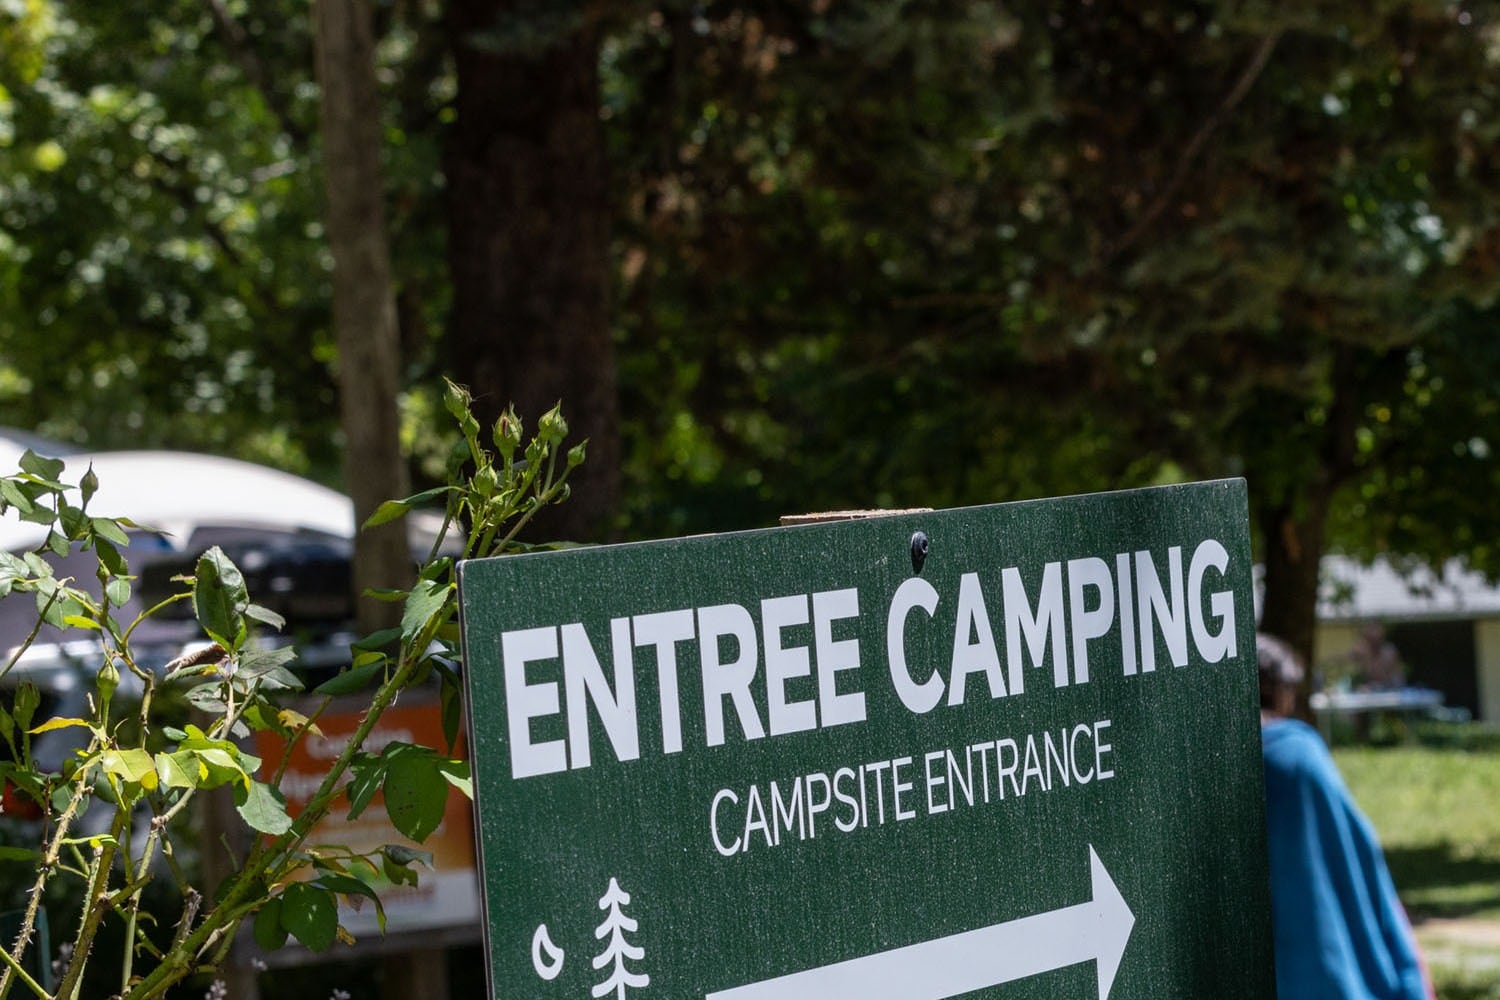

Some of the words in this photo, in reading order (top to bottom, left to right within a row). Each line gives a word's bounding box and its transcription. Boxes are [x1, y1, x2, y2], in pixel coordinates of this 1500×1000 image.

[501, 588, 867, 779] ENTREE
[887, 539, 1238, 713] CAMPING
[710, 757, 915, 857] CAMPSITE
[925, 720, 1115, 815] ENTRANCE
